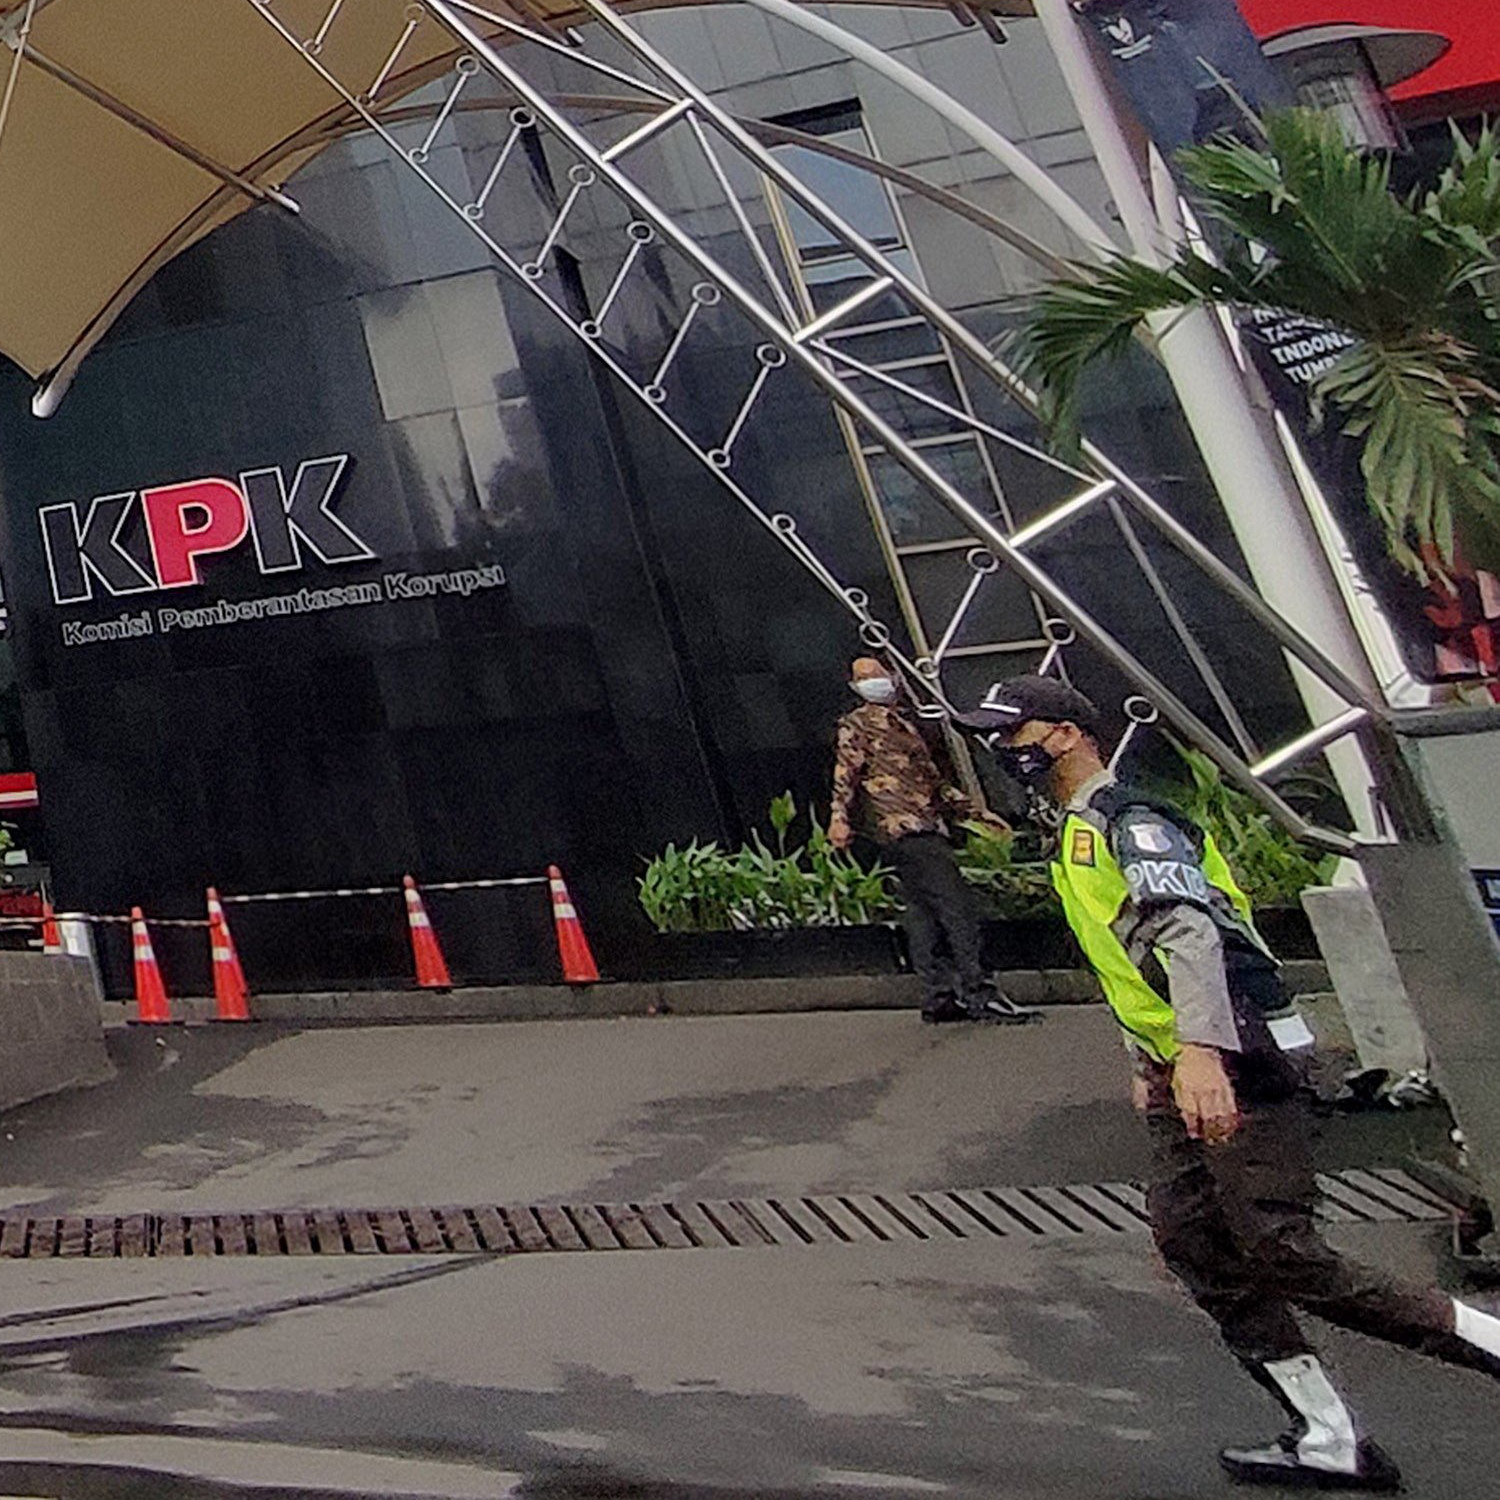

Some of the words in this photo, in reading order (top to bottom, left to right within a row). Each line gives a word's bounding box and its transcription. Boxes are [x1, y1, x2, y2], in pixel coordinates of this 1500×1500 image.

[38, 454, 376, 604] KPK
[62, 611, 153, 645] Komisi
[158, 580, 382, 633] Pemberantasan
[383, 564, 506, 599] Korupsi
